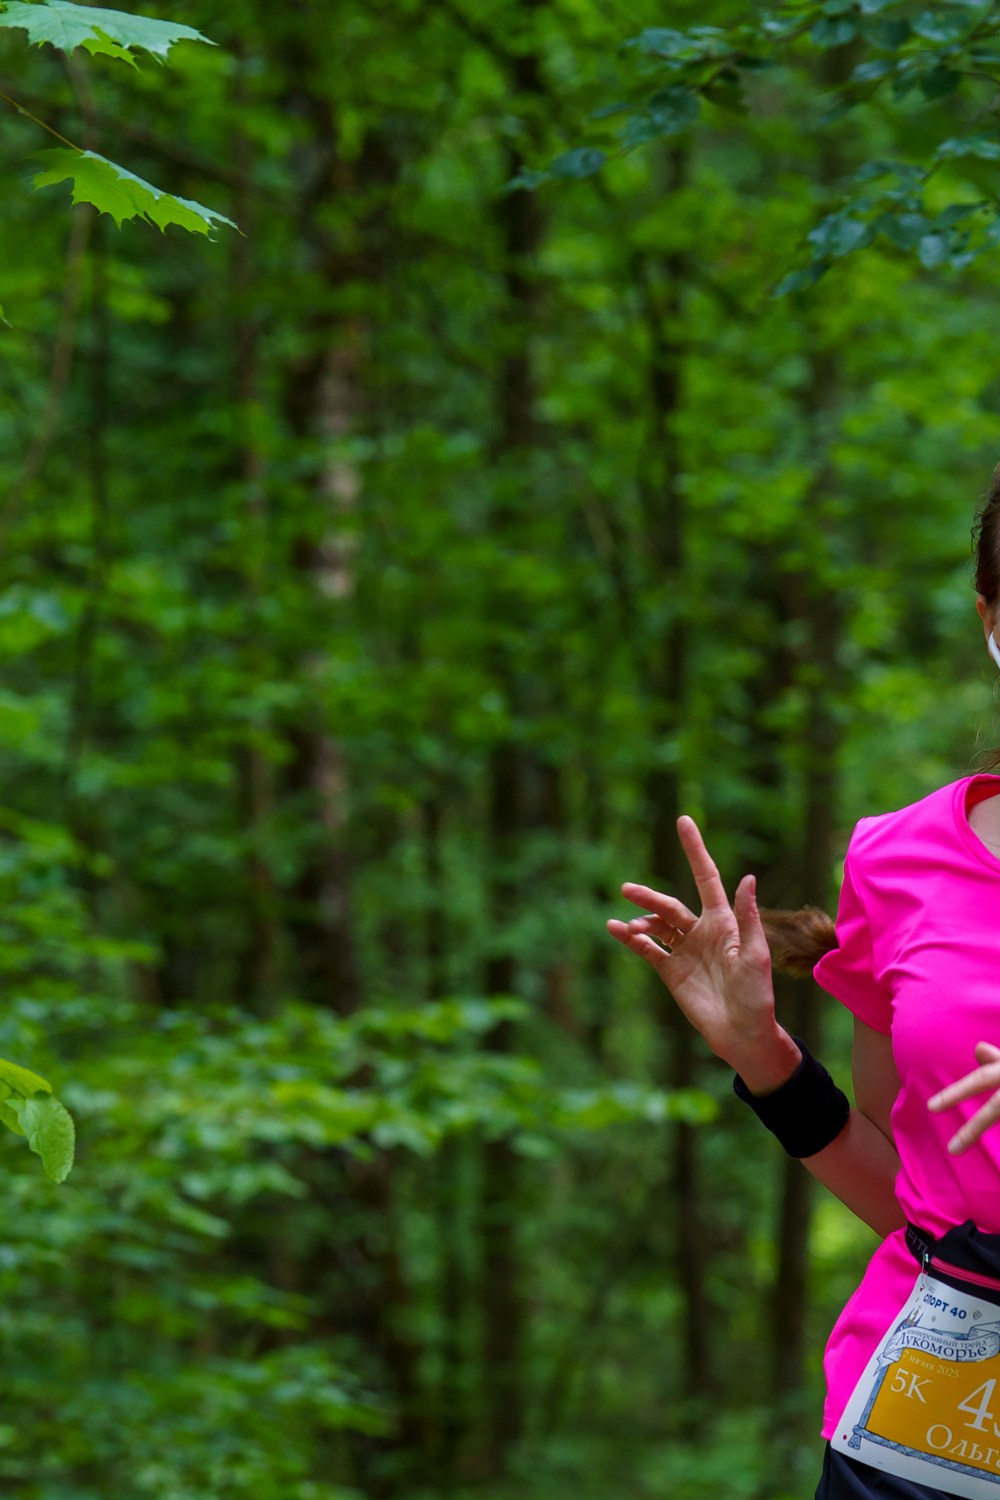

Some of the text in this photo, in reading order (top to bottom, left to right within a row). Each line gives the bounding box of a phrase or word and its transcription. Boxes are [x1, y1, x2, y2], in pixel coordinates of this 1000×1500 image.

[923, 1293, 967, 1320] СПОРТ 40
[895, 1332, 987, 1362] Лукоморье
[936, 1365, 960, 1378] 2025
